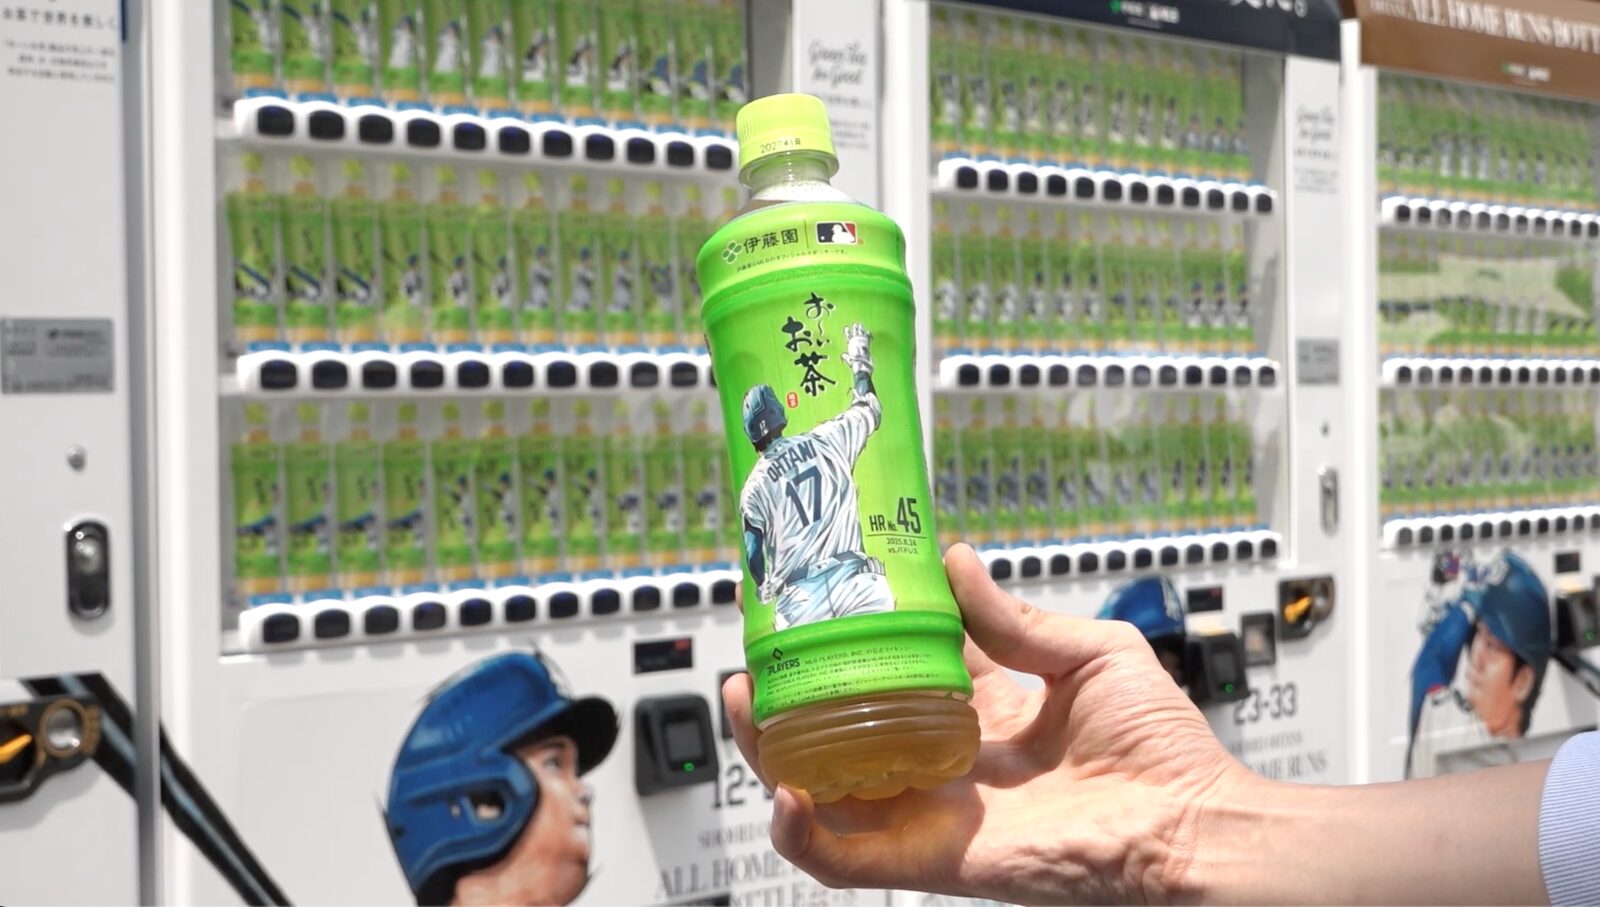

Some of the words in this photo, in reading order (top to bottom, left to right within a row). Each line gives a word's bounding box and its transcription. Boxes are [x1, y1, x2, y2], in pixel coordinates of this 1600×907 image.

[743, 228, 799, 254] 伊藤園
[767, 440, 817, 483] OHTANI
[785, 465, 822, 528] 17
[869, 514, 887, 532] HR
[897, 496, 922, 534] 45
[766, 657, 800, 676] PLAYERS
[1234, 683, 1297, 726] 23-33
[711, 763, 774, 809] 12-
